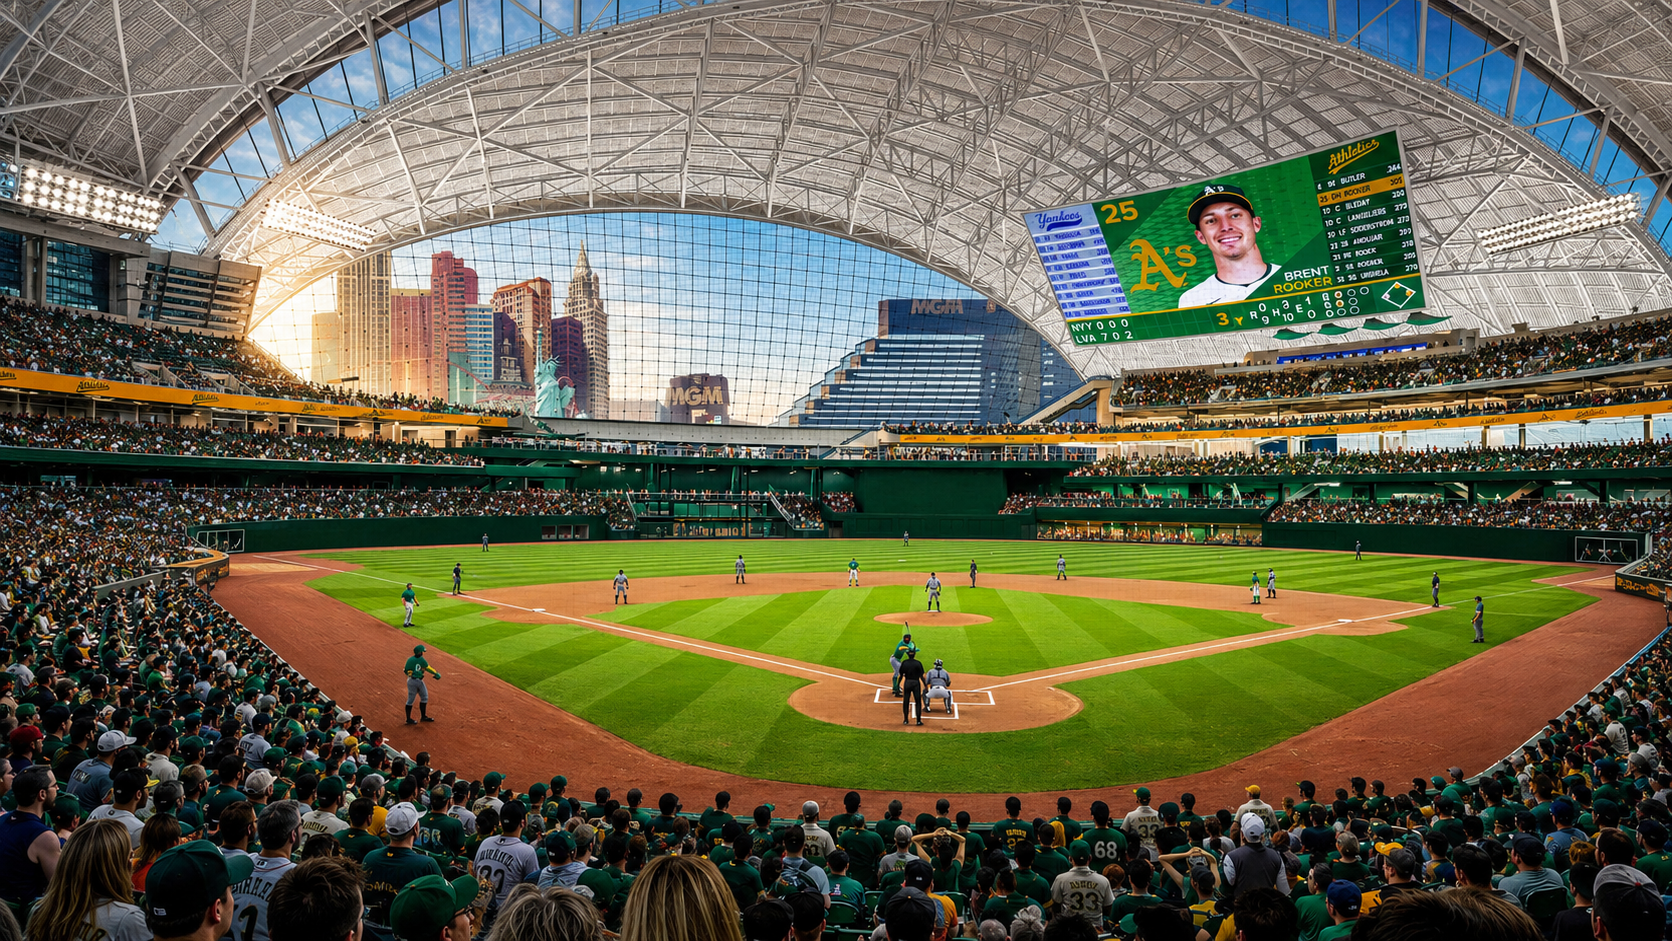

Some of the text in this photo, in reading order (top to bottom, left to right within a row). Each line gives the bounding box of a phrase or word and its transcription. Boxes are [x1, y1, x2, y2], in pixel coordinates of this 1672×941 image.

[1101, 200, 1138, 224] 25
[1130, 239, 1197, 294] A's
[1284, 265, 1329, 282] BRENT
[1273, 276, 1333, 294] ROOKER
[1216, 312, 1230, 326] 3
[1249, 310, 1258, 320] R
[1272, 308, 1280, 317] H
[1295, 304, 1303, 313] E
[1259, 302, 1267, 312] 0
[1071, 318, 1128, 332] NYY 0 0 0
[1282, 312, 1294, 322] 10
[1075, 330, 1133, 344] LVA 7 0 2
[664, 385, 724, 407] MGM
[1094, 840, 1118, 860] 68
[1070, 891, 1099, 912] 33
